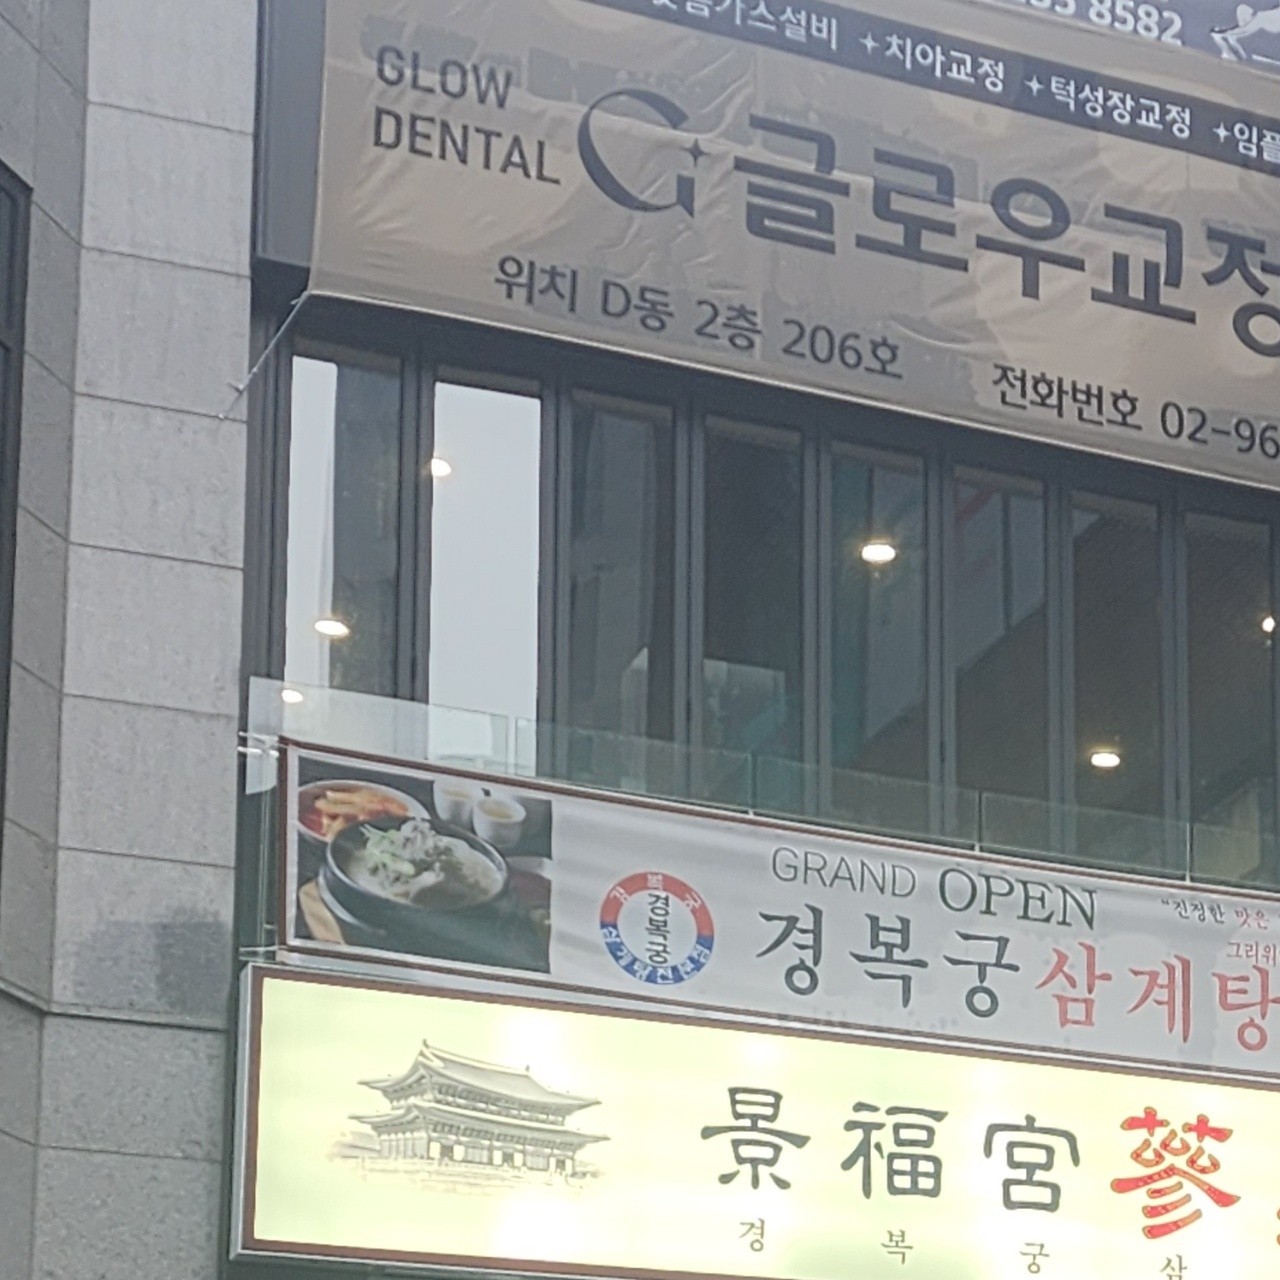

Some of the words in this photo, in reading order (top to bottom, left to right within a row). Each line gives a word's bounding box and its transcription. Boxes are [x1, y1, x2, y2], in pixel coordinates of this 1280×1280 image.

[1088, 0, 1183, 46] 8582
[375, 46, 512, 108] GLOW
[885, 34, 1005, 91] 치아교정
[1050, 77, 1192, 138] 턱성장교정
[374, 108, 561, 185] DENTAL
[495, 255, 576, 312] 위치
[603, 280, 675, 331] D동
[695, 301, 762, 351] 2층
[782, 321, 903, 380] 206호
[992, 364, 1143, 432] 전화번호
[771, 847, 917, 898] GRAND
[938, 867, 1097, 930] OPEN
[1235, 906, 1270, 930] 맛은
